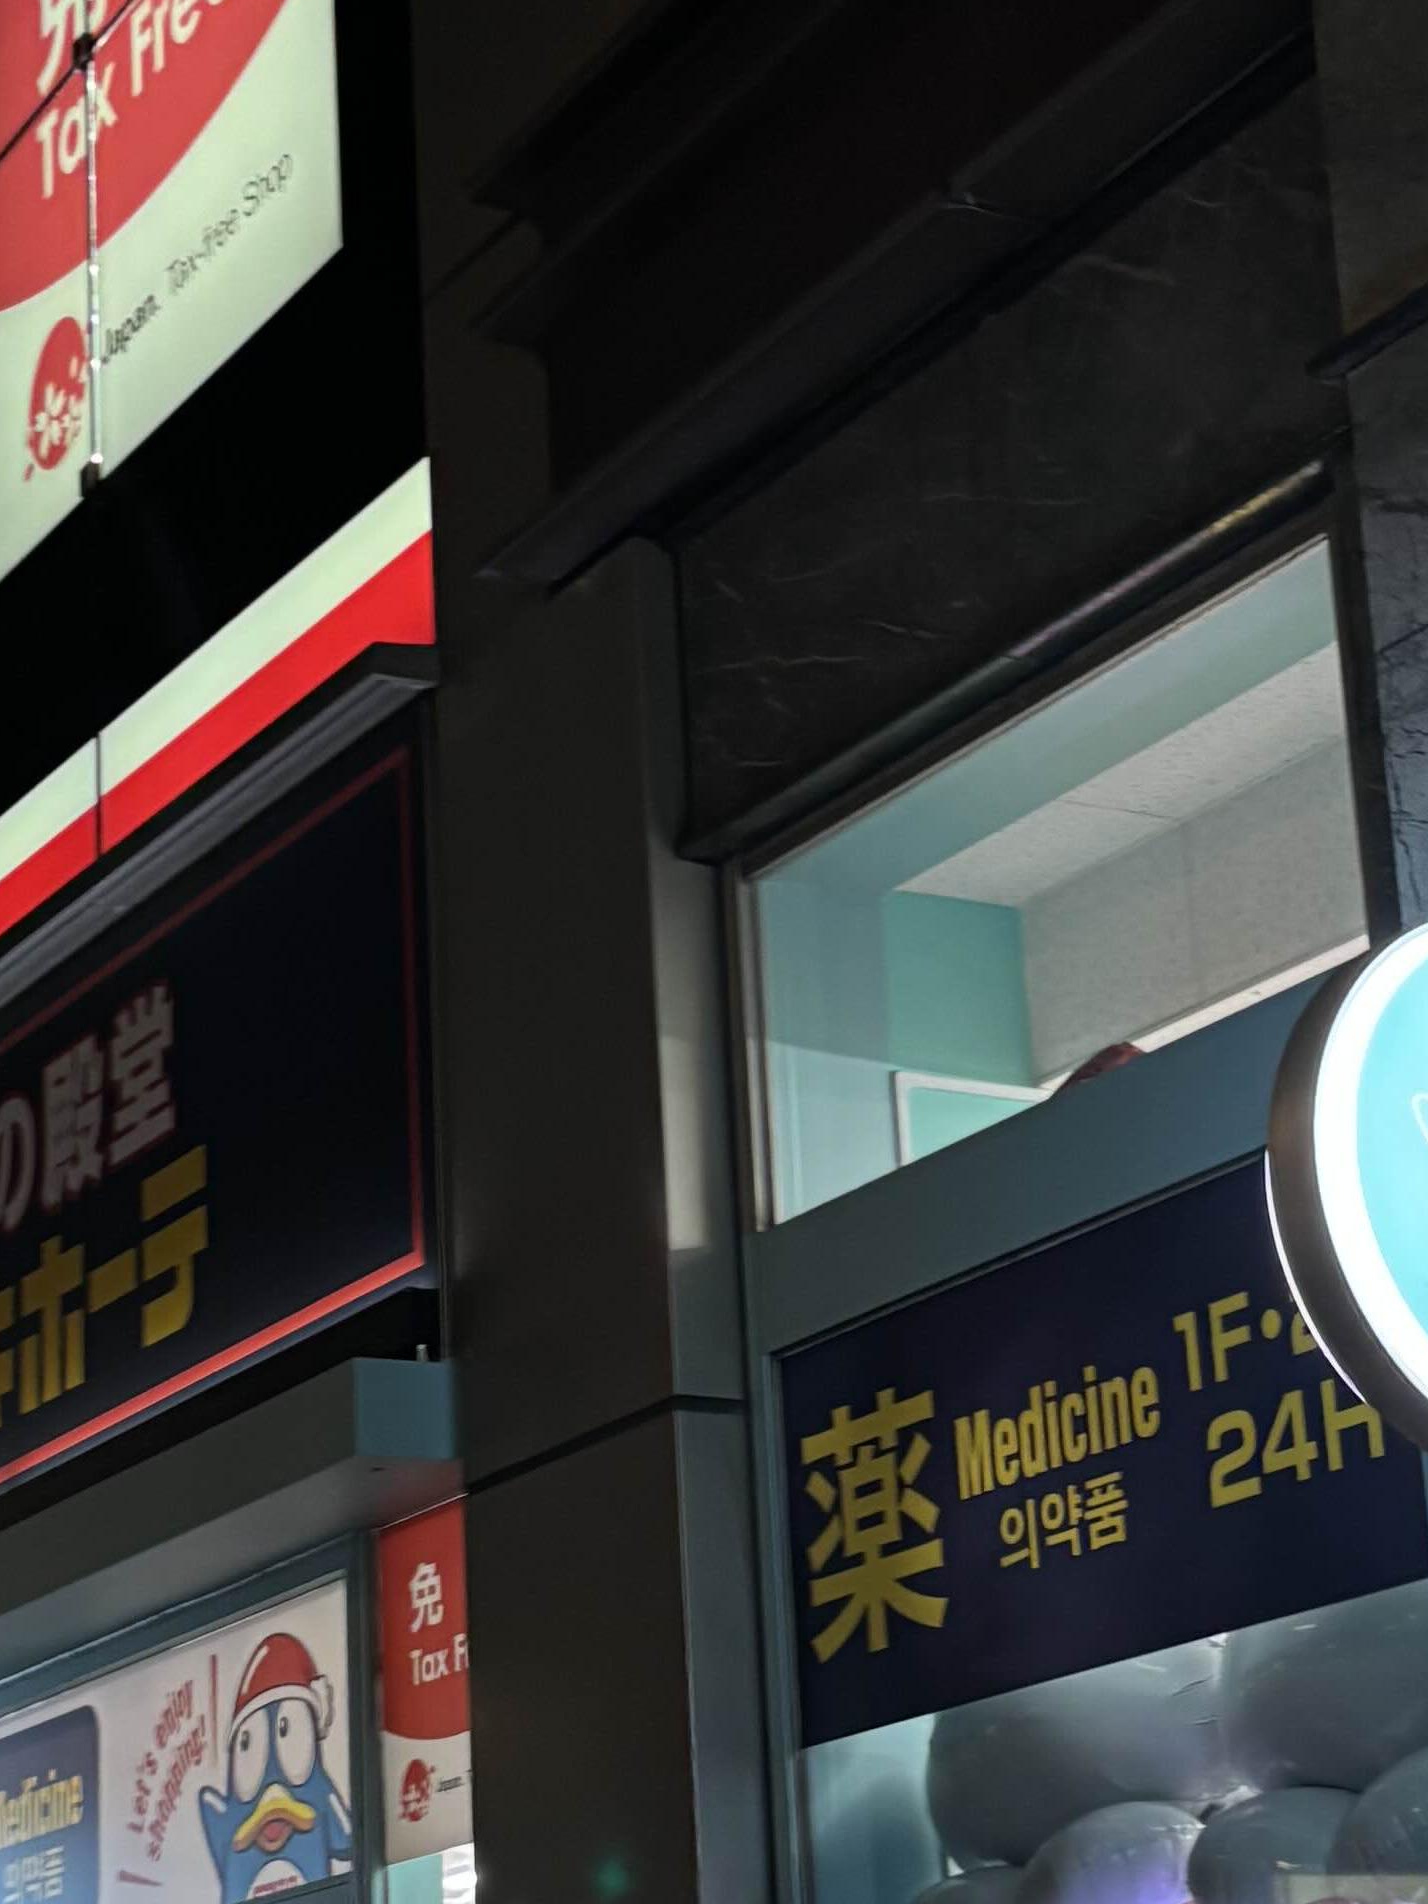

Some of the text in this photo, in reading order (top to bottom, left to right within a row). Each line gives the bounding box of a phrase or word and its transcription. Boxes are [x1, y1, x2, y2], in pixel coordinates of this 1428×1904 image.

[36, 62, 118, 198] Tax
[955, 1364, 1161, 1501] Medicine
[1207, 1379, 1385, 1509] 24H
[800, 1388, 948, 1663] 薬
[999, 1471, 1128, 1570] 의약품
[408, 1562, 444, 1633] 免
[154, 1679, 194, 1749] enjoy
[409, 1648, 449, 1686] Tax
[147, 1713, 208, 1863] shopping!
